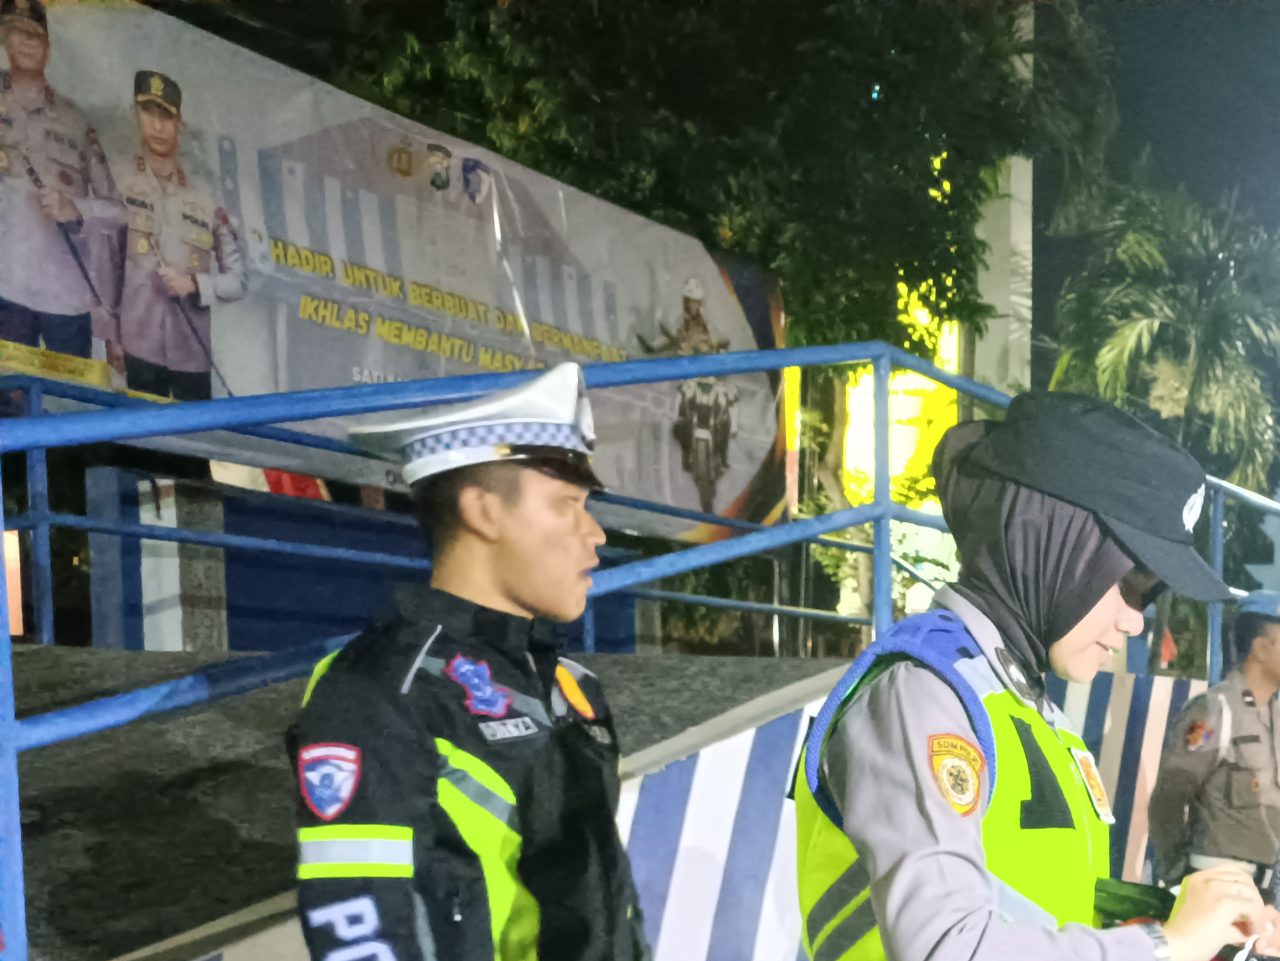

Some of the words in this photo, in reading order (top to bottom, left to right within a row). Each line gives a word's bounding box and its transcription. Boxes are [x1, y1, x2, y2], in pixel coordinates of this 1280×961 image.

[270, 238, 335, 279] HADIR
[341, 261, 406, 298] UNTUK
[299, 295, 372, 335] IKHLAS
[375, 316, 474, 364] MEMBANTU
